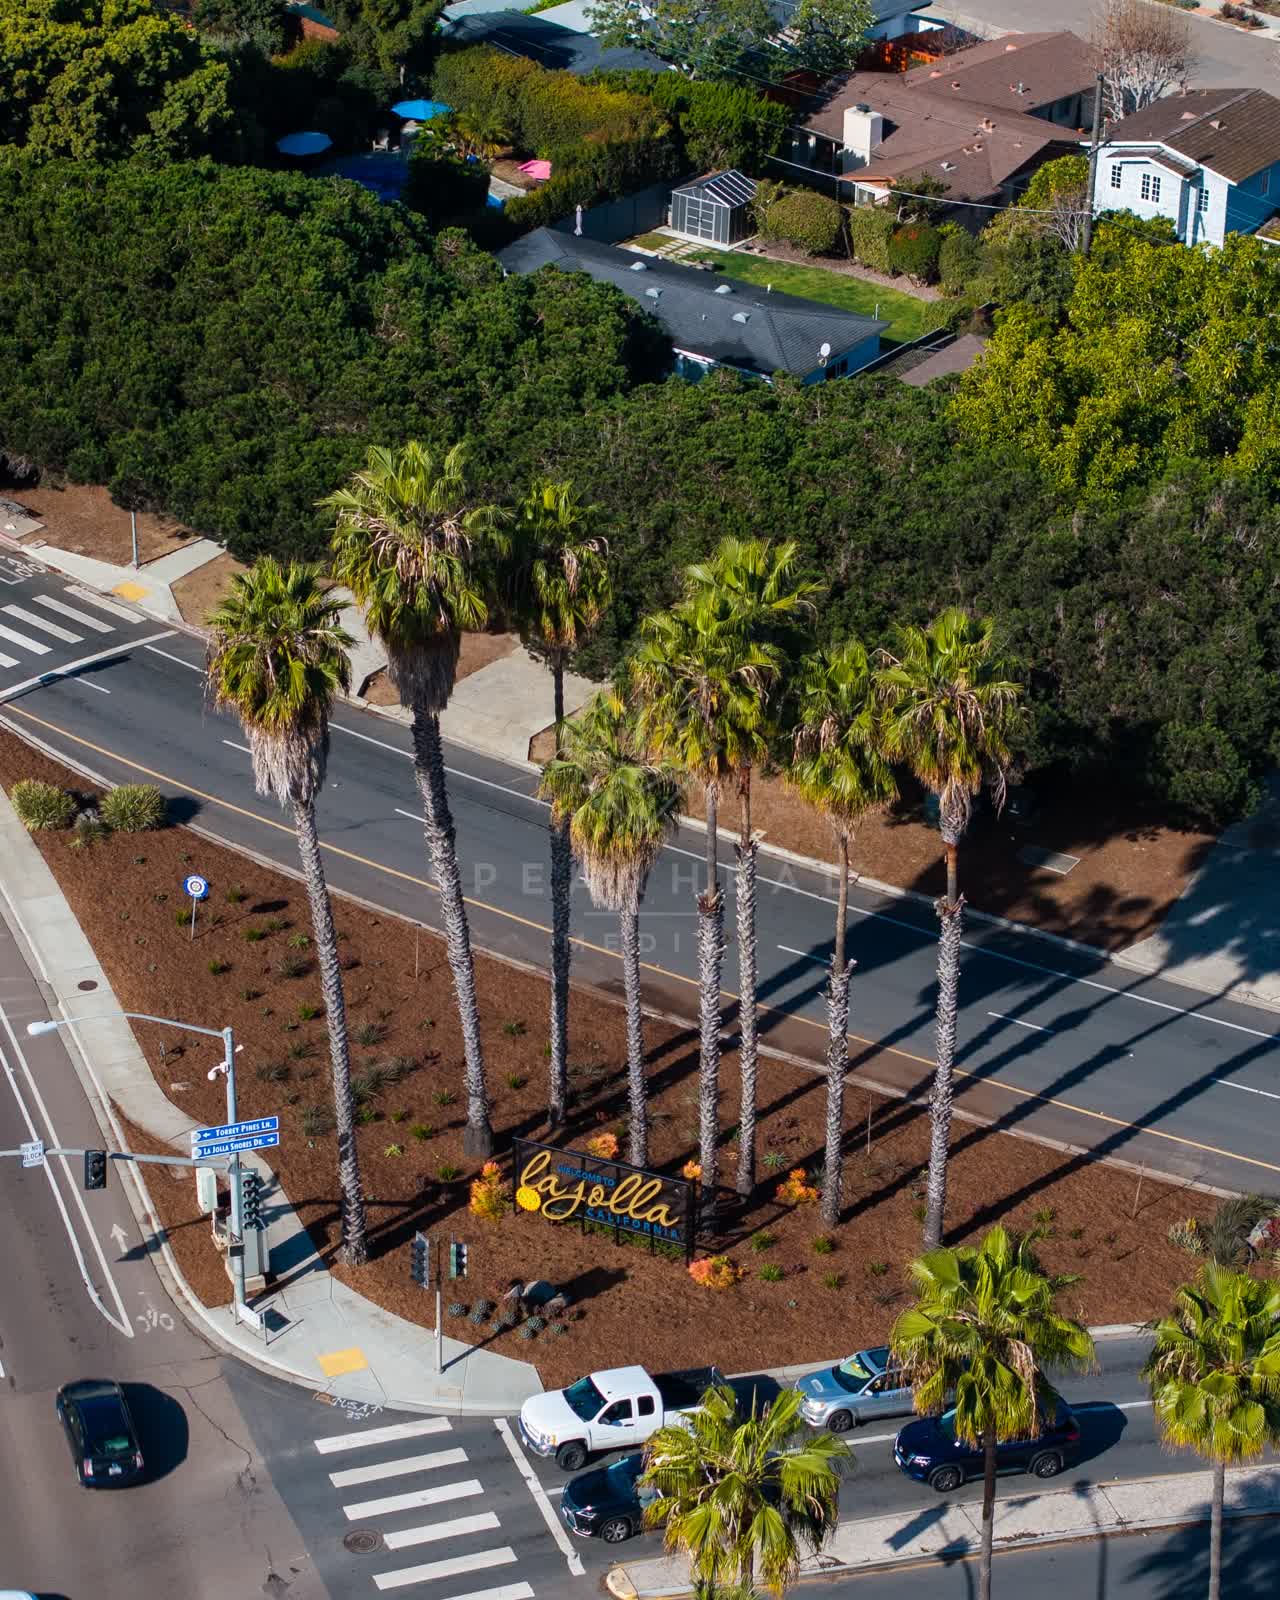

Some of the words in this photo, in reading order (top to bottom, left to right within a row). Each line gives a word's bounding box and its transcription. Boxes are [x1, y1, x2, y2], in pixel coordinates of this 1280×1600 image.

[216, 1127, 240, 1136] TORREY
[241, 1123, 260, 1132] PINES
[203, 1147, 211, 1155] LA
[212, 1145, 229, 1153] JOLLA
[231, 1140, 252, 1150] SHORES
[558, 1164, 601, 1184] WELCOME
[603, 1176, 616, 1187] TO
[586, 1207, 679, 1240] CALIFORNIA
